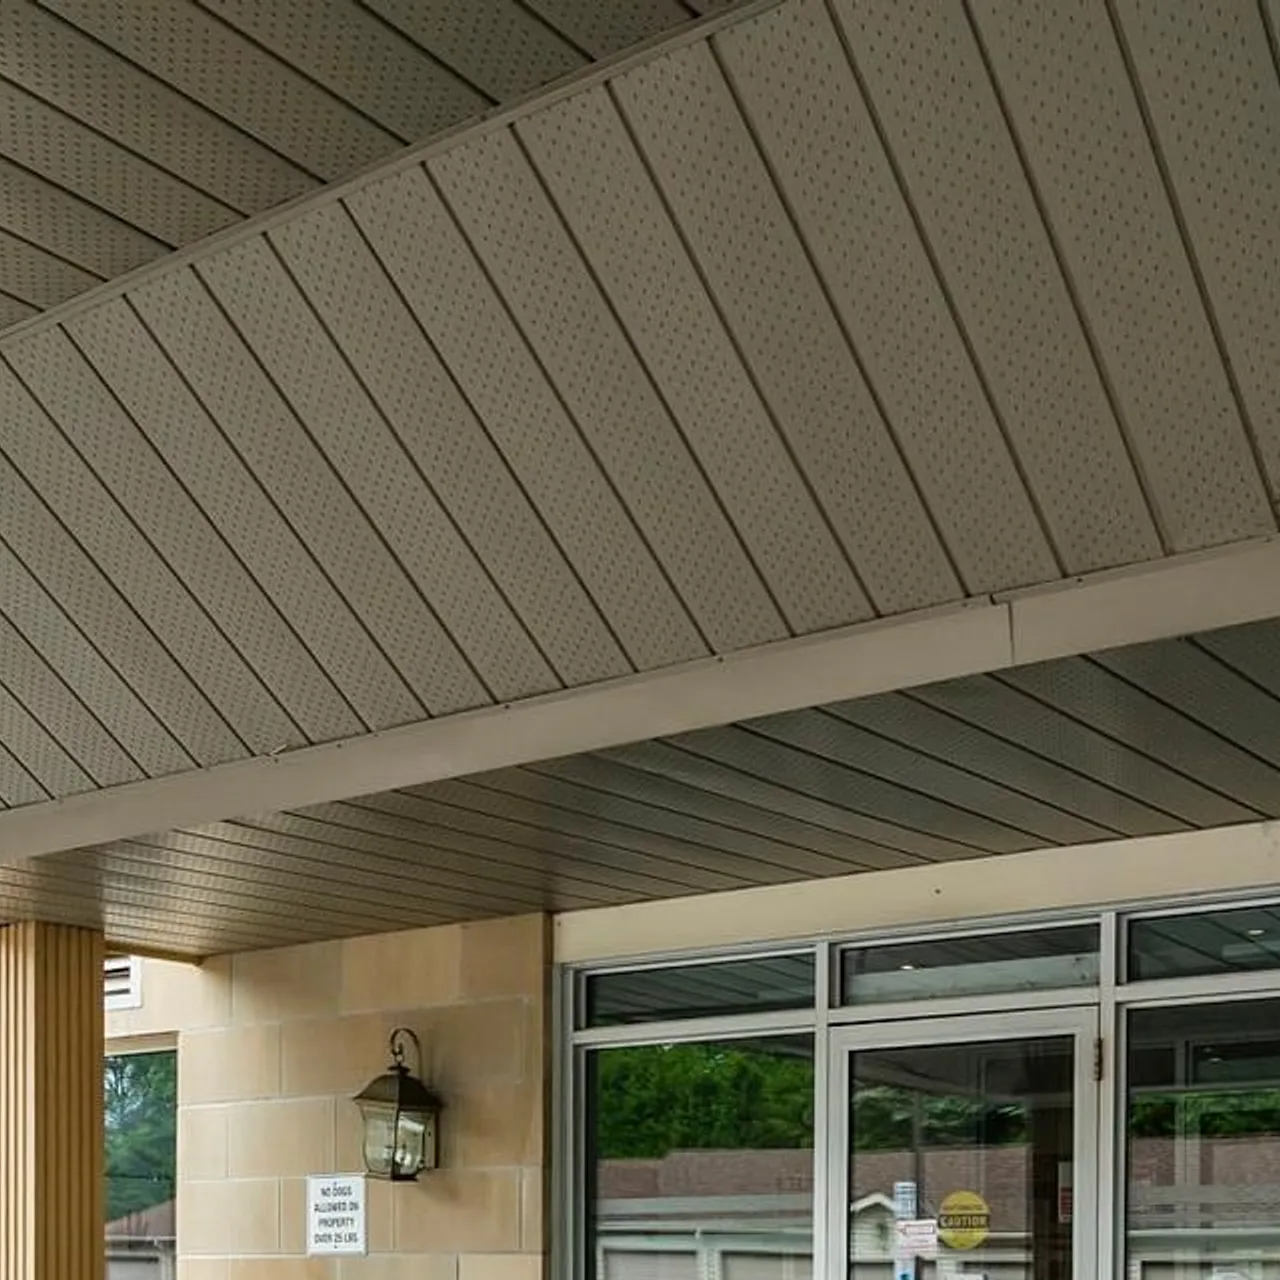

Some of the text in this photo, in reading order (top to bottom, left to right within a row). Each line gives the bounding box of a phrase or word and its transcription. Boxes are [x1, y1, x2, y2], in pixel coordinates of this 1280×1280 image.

[320, 1187, 331, 1197] NO
[318, 1217, 354, 1227] PROPERTY
[939, 1215, 988, 1228] CAUTION
